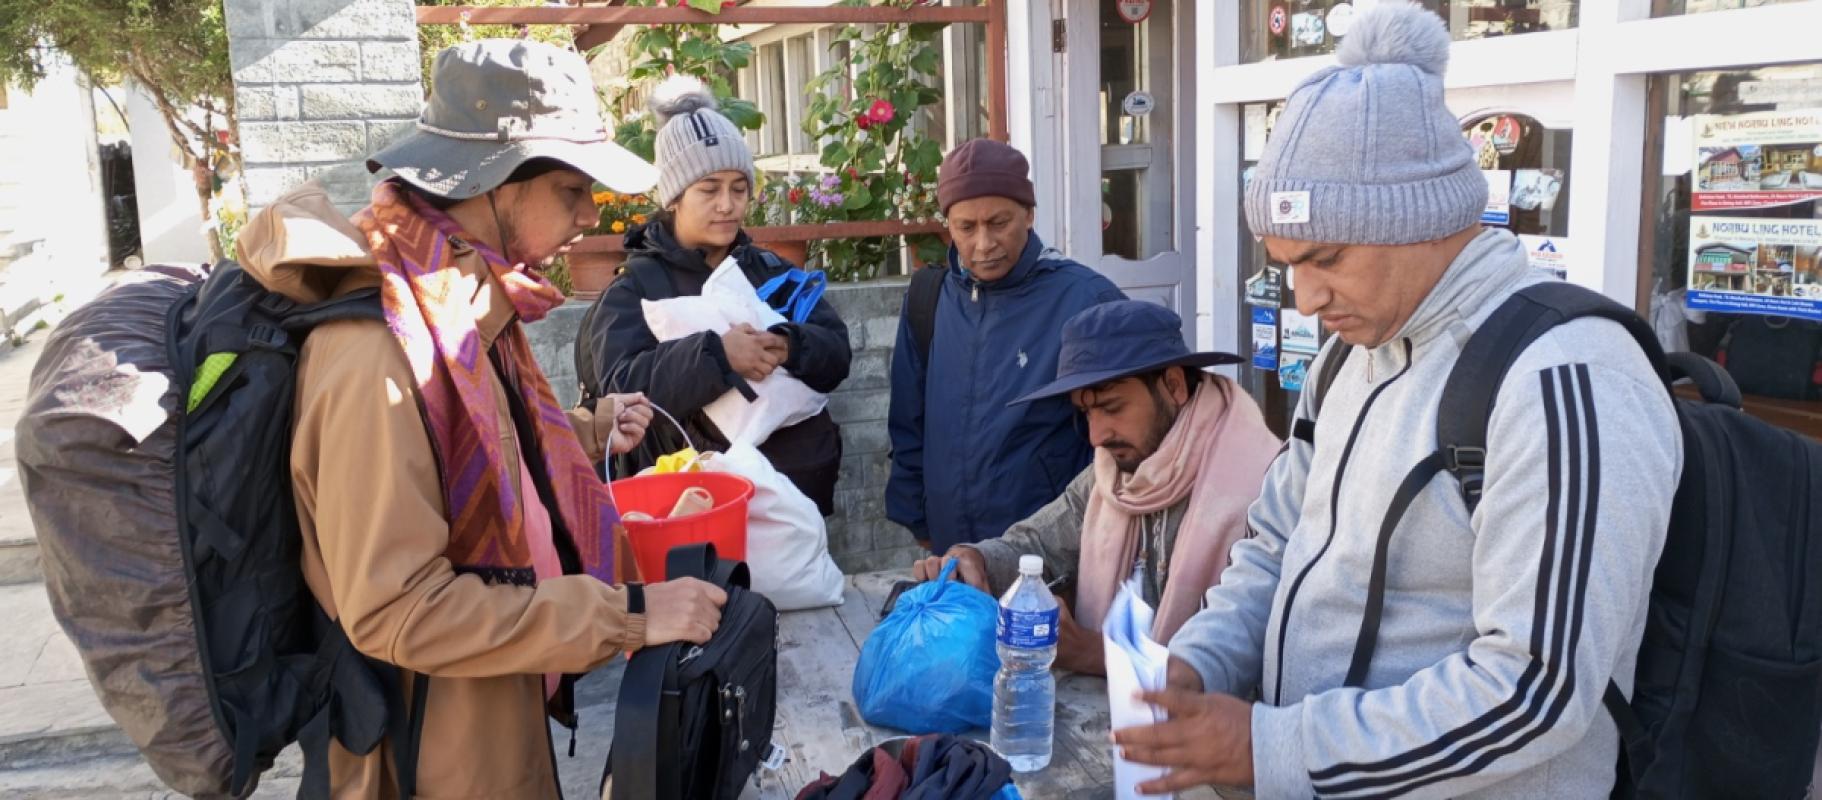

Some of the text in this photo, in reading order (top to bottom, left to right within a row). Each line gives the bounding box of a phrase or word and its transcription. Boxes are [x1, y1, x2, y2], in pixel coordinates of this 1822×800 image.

[1738, 118, 1768, 130] NORBU
[1771, 117, 1793, 128] LING
[1712, 222, 1821, 236] NORBU LING HOTEL
